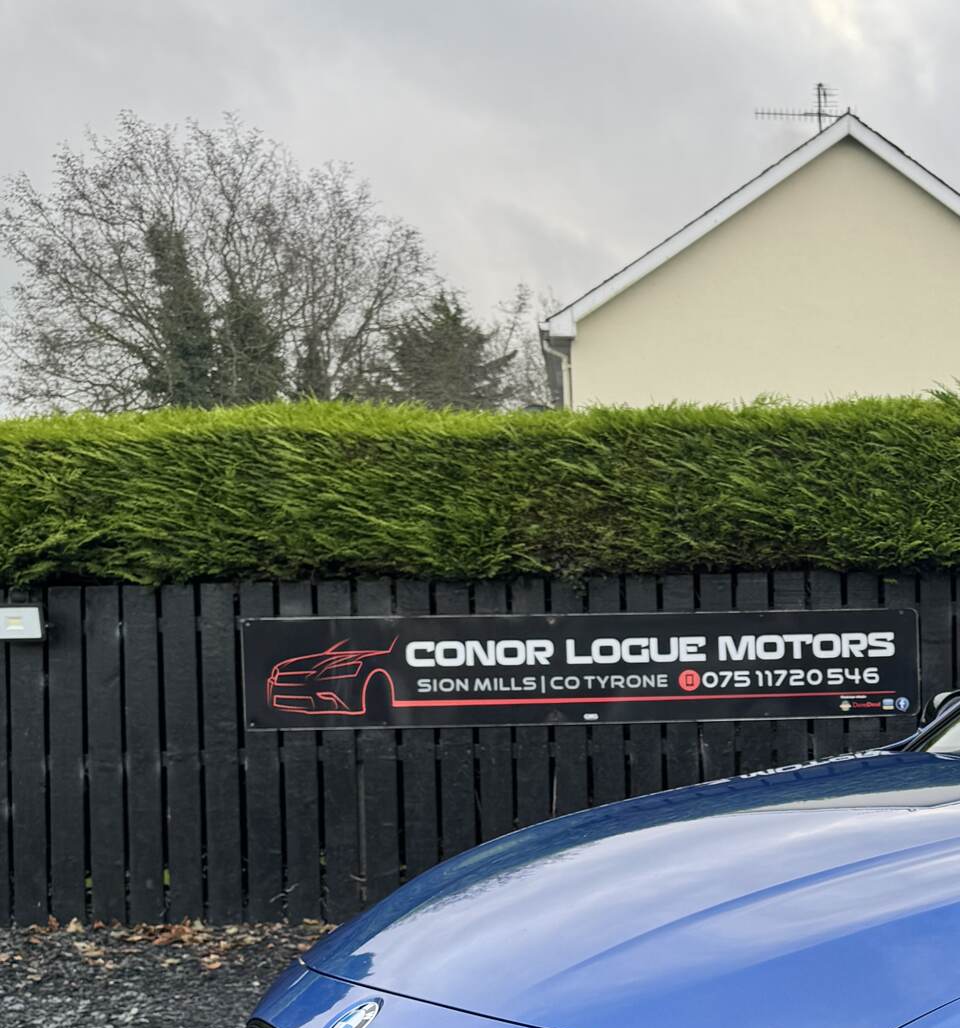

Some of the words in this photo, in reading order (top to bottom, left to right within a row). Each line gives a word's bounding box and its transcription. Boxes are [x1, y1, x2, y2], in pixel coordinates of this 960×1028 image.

[405, 639, 555, 667] CONOR
[565, 636, 707, 664] LOGUE
[718, 632, 896, 661] MOTORS
[417, 678, 469, 692] SION
[473, 676, 537, 691] MILLS
[550, 676, 580, 690] CO
[583, 674, 669, 689] TYRONE
